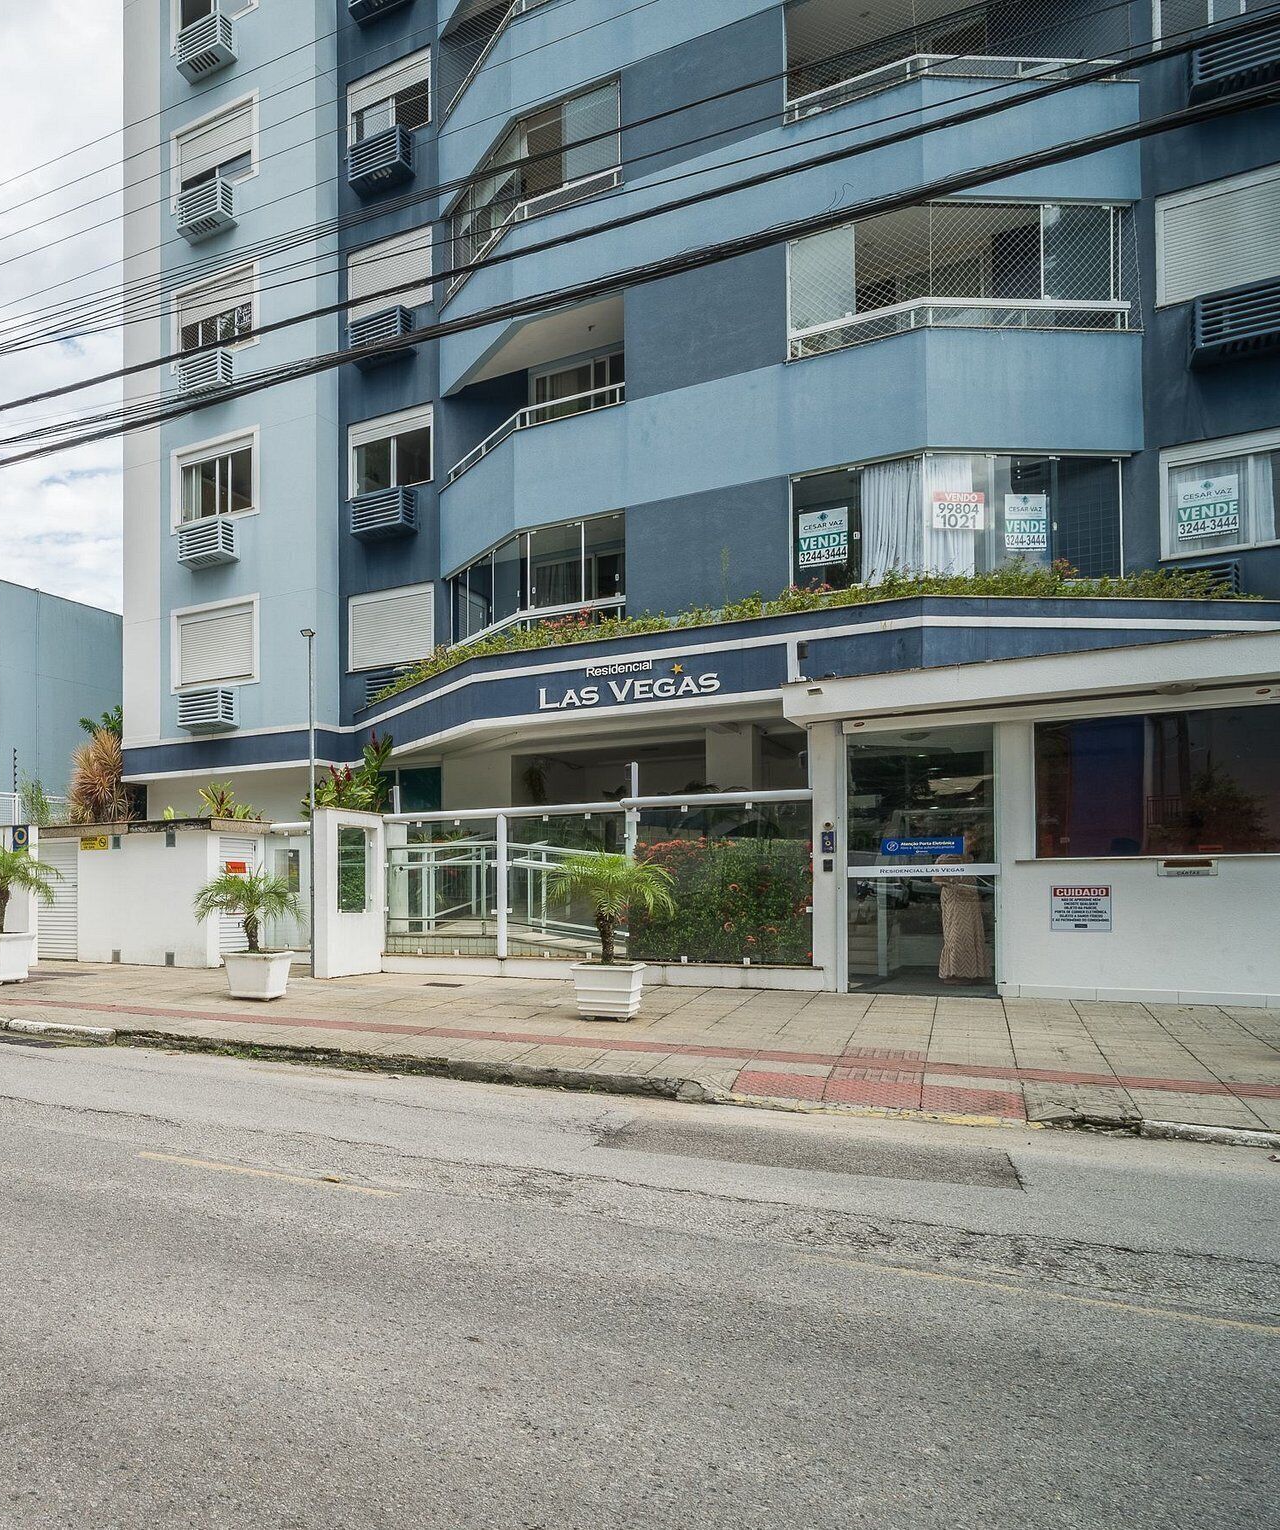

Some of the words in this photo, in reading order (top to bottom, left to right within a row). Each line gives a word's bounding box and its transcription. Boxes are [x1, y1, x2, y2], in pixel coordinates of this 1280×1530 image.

[944, 492, 978, 502] VENDO
[1183, 491, 1212, 500] CESAR
[1214, 487, 1232, 495] VAZ
[938, 503, 980, 514] 99804
[1179, 501, 1238, 521] VENDE
[803, 522, 827, 531] CESAR
[829, 519, 844, 527] VAZ
[940, 513, 977, 528] 1021
[1005, 520, 1046, 533] VENDE
[1180, 516, 1238, 535] 3244-3444
[800, 532, 848, 551] VENDE
[1005, 534, 1046, 546] 3244-3444
[800, 546, 847, 563] 3244-3444
[586, 660, 652, 678] Residencial
[538, 686, 600, 710] LAS
[607, 673, 721, 703] VEGAS
